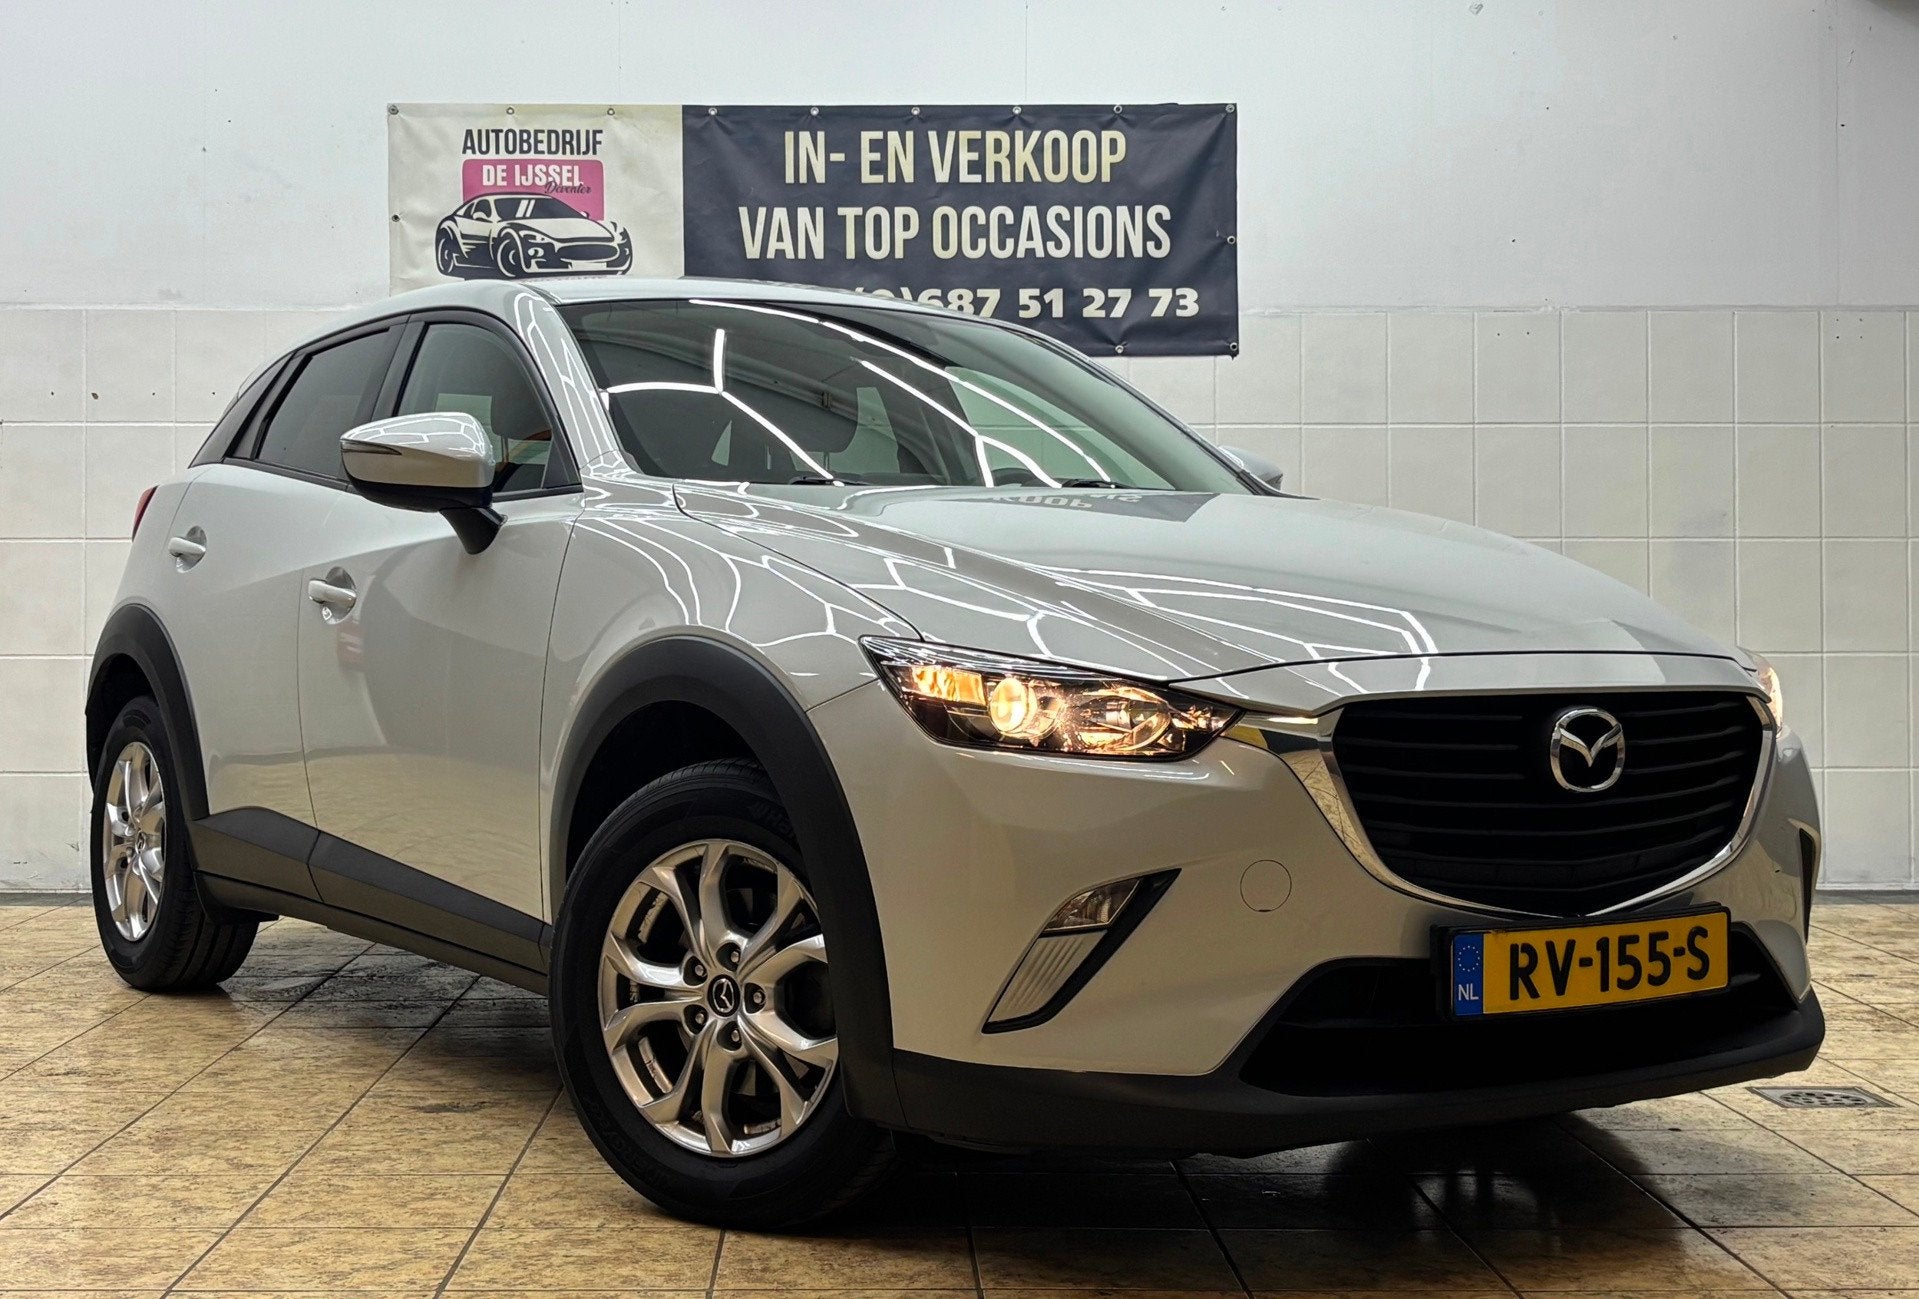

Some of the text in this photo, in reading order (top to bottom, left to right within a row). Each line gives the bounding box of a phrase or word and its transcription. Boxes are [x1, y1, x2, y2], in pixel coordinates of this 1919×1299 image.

[461, 128, 604, 156] AUTOBEDRIJF
[784, 129, 1127, 184] IN- EN VERKOOP
[482, 164, 584, 187] DE IJSSEL
[738, 204, 1172, 260] VAN TOP OCCASIONS
[1018, 288, 1064, 319] 51
[1082, 287, 1132, 318] 27
[1148, 287, 1200, 317] 73
[1508, 925, 1711, 1002] RV-155-S
[1457, 983, 1480, 1001] NL
